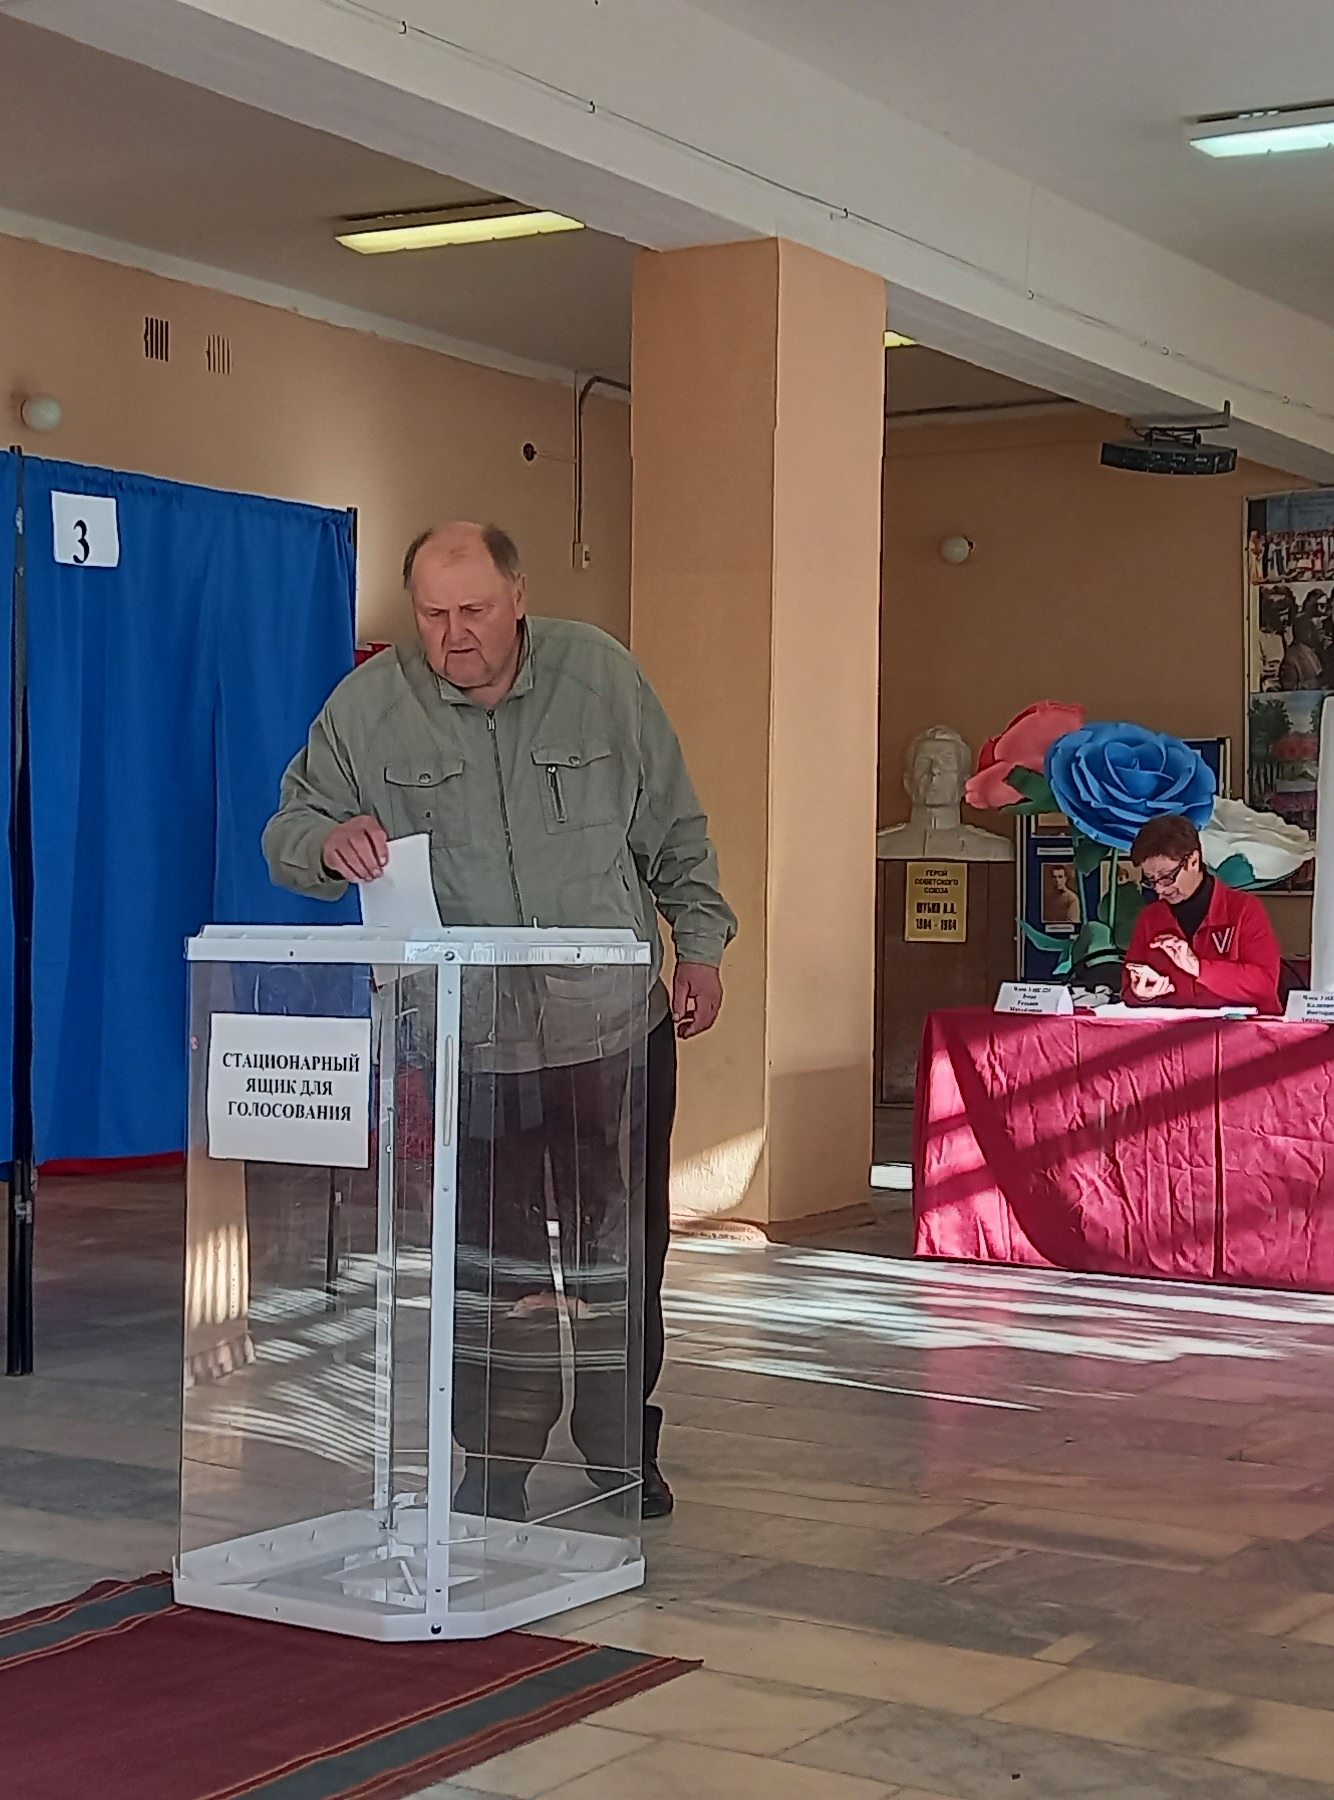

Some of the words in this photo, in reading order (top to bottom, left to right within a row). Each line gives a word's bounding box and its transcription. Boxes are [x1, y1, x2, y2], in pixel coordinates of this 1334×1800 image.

[73, 519, 90, 564] 3
[914, 878, 959, 886] СОВЕТСКОГО
[925, 869, 948, 877] ГЕРОЙ
[222, 1052, 360, 1073] СТАЦИОНАРНЫЙ
[245, 1078, 297, 1095] ЯЩИК
[300, 1080, 333, 1097] ДЛЯ
[227, 1101, 352, 1122] ГОЛОСОВАНИЯ
